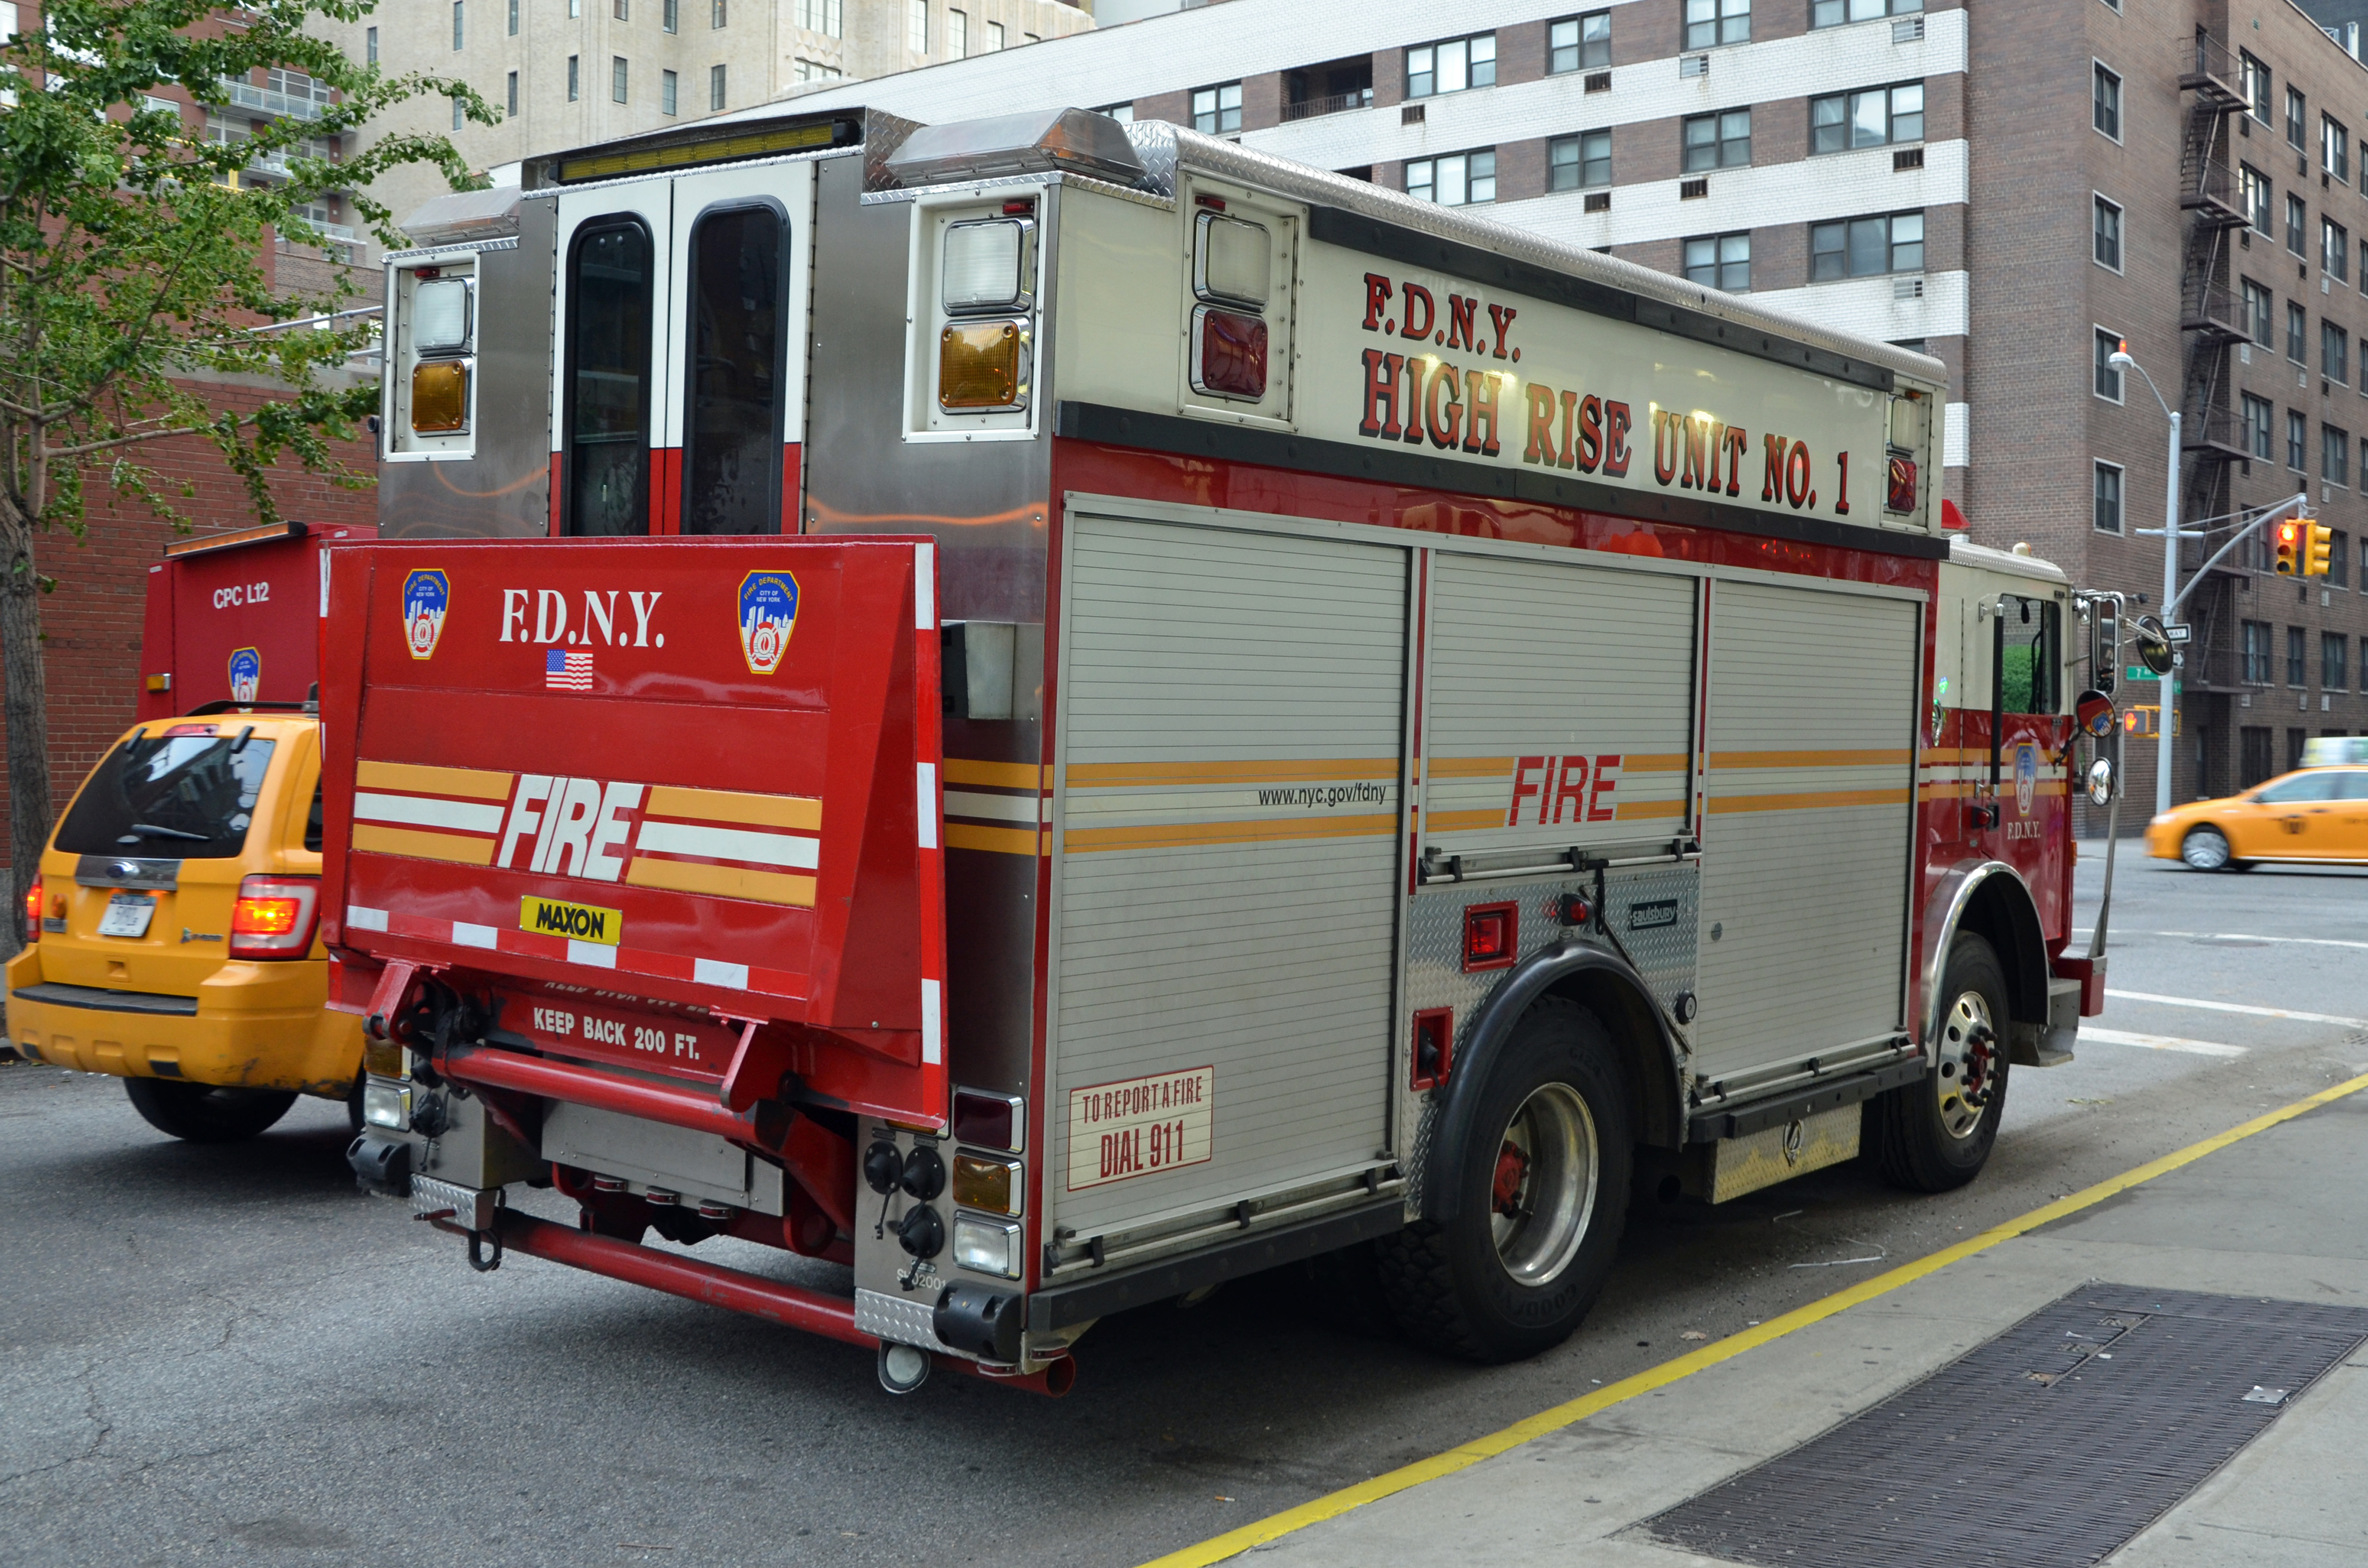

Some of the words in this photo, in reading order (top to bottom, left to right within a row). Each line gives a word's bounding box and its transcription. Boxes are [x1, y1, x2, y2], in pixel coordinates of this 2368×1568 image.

[1362, 272, 1520, 363] F.D.N.Y.
[1359, 348, 1503, 457] HIGH
[1523, 382, 1632, 478] RISE
[1653, 410, 1747, 497] UNIT
[1762, 433, 1816, 510] NO.
[1835, 451, 1850, 515] 1
[213, 586, 243, 609] CPC
[247, 581, 269, 603] L12
[744, 583, 757, 600] FIRE
[758, 576, 794, 602] DEPARTMENT
[499, 589, 664, 648] F.D.N.Y.
[1258, 783, 1386, 808] www.nyc.gov/fdny
[1509, 755, 1621, 826] FIRE
[497, 774, 645, 882] FIRE
[2007, 821, 2040, 840] F.D.N.Y.
[535, 903, 605, 939] MAXON
[534, 1007, 575, 1034] KEEP
[583, 1016, 626, 1046] BACK
[634, 1027, 666, 1054] 200
[675, 1033, 700, 1060] FT.
[1083, 1093, 1100, 1124] TO
[1104, 1083, 1159, 1120] REPORT
[1162, 1082, 1170, 1108] A
[1173, 1076, 1202, 1107] FIRE
[1100, 1128, 1143, 1178] DIAL
[1150, 1119, 1183, 1167] 911
